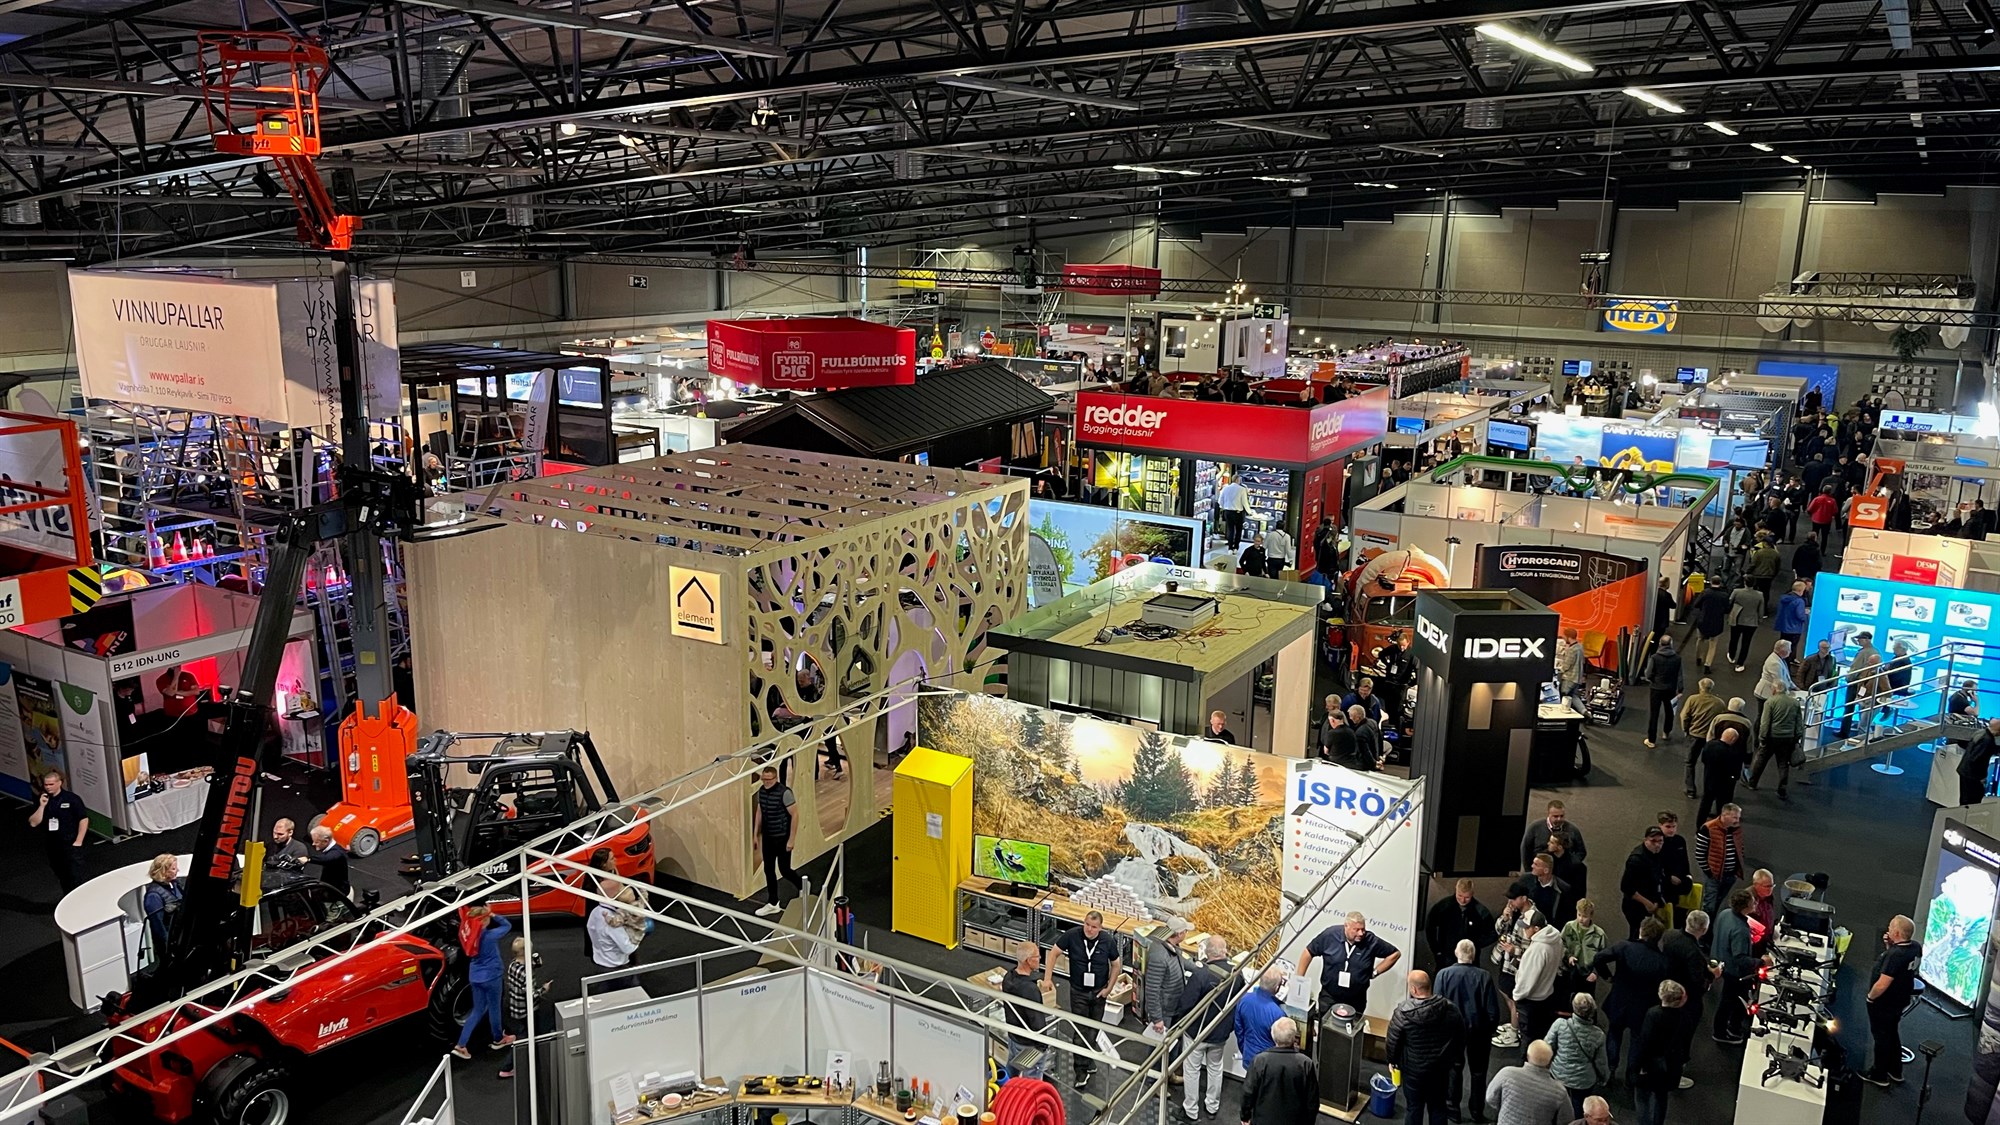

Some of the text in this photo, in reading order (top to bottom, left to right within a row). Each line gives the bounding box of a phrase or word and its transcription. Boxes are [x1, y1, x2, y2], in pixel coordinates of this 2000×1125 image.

[112, 299, 225, 330] VINNUPALLAR
[1609, 309, 1660, 324] IKEA
[777, 355, 811, 365] FYRIR
[821, 354, 907, 368] FULLBÚIN HÚS
[781, 365, 807, 378] ÞIG
[1084, 403, 1168, 429] redder
[1311, 411, 1345, 441] redder
[1603, 426, 1678, 440] SAMEY ROBOTICS
[1507, 557, 1578, 567] HYDROSCAND
[677, 610, 714, 626] element
[1417, 614, 1449, 654] IDEX
[1463, 637, 1546, 659] IDEX
[113, 649, 181, 673] B12 IDN-UNG
[1297, 773, 1413, 821] ÍSRÖR
[209, 756, 257, 880] MANITOU
[611, 1013, 678, 1033] endurvinnsla málma
[626, 1008, 662, 1021] MÁLMAR
